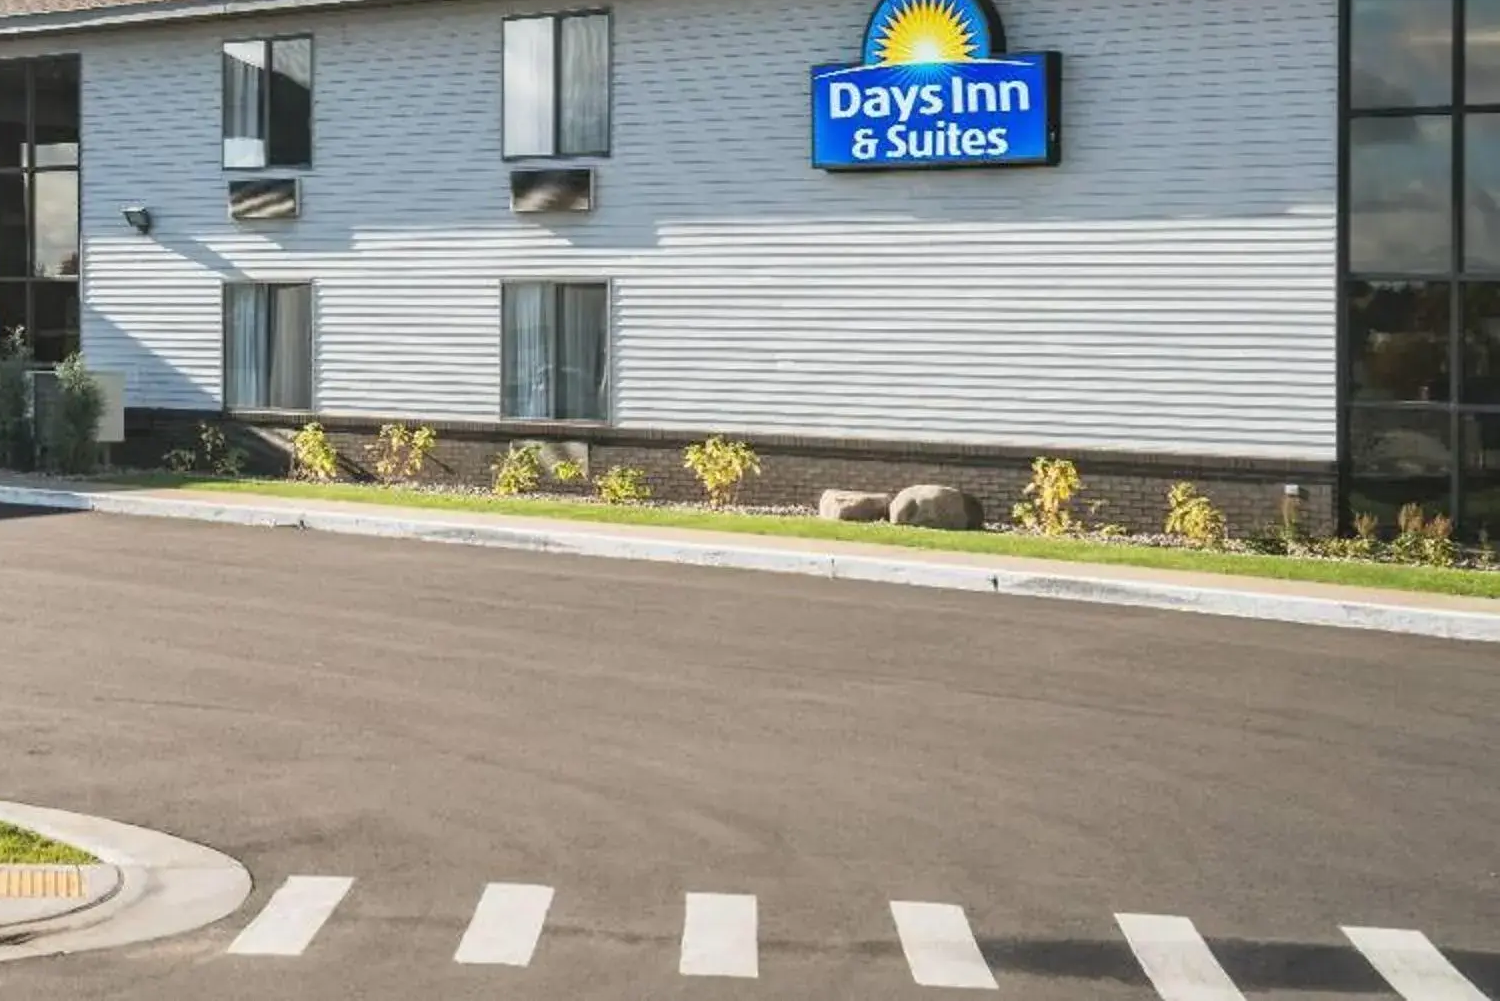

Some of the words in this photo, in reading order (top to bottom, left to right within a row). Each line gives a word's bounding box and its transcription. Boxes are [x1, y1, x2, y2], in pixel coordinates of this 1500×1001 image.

[829, 82, 942, 122] Days
[952, 76, 1030, 114] Inn
[851, 128, 878, 159] &
[886, 121, 1008, 158] Suites
